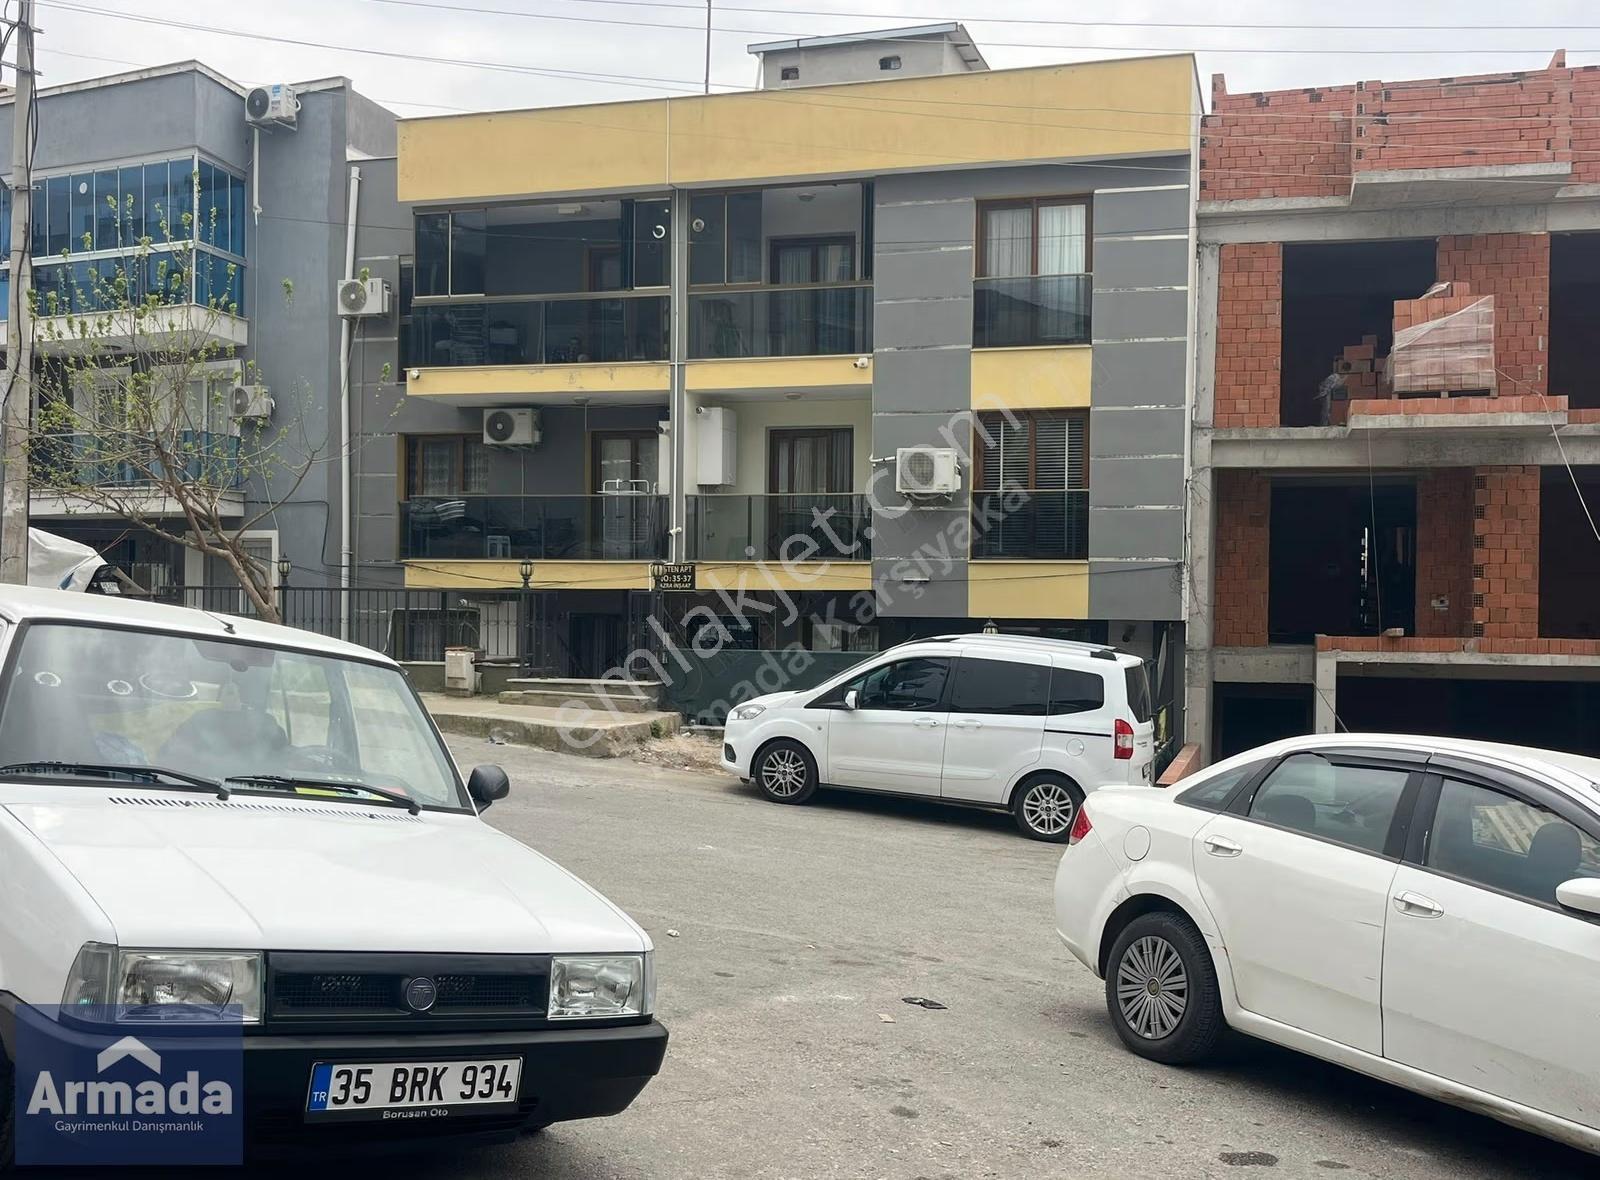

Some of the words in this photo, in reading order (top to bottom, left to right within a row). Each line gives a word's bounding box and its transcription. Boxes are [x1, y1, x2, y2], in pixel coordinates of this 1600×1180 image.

[313, 1091, 327, 1102] TR
[332, 1068, 373, 1105] 35
[389, 1066, 449, 1103] BRK
[459, 1064, 513, 1100] 934
[382, 1109, 427, 1120] Borusan
[430, 1108, 449, 1118] Oto
